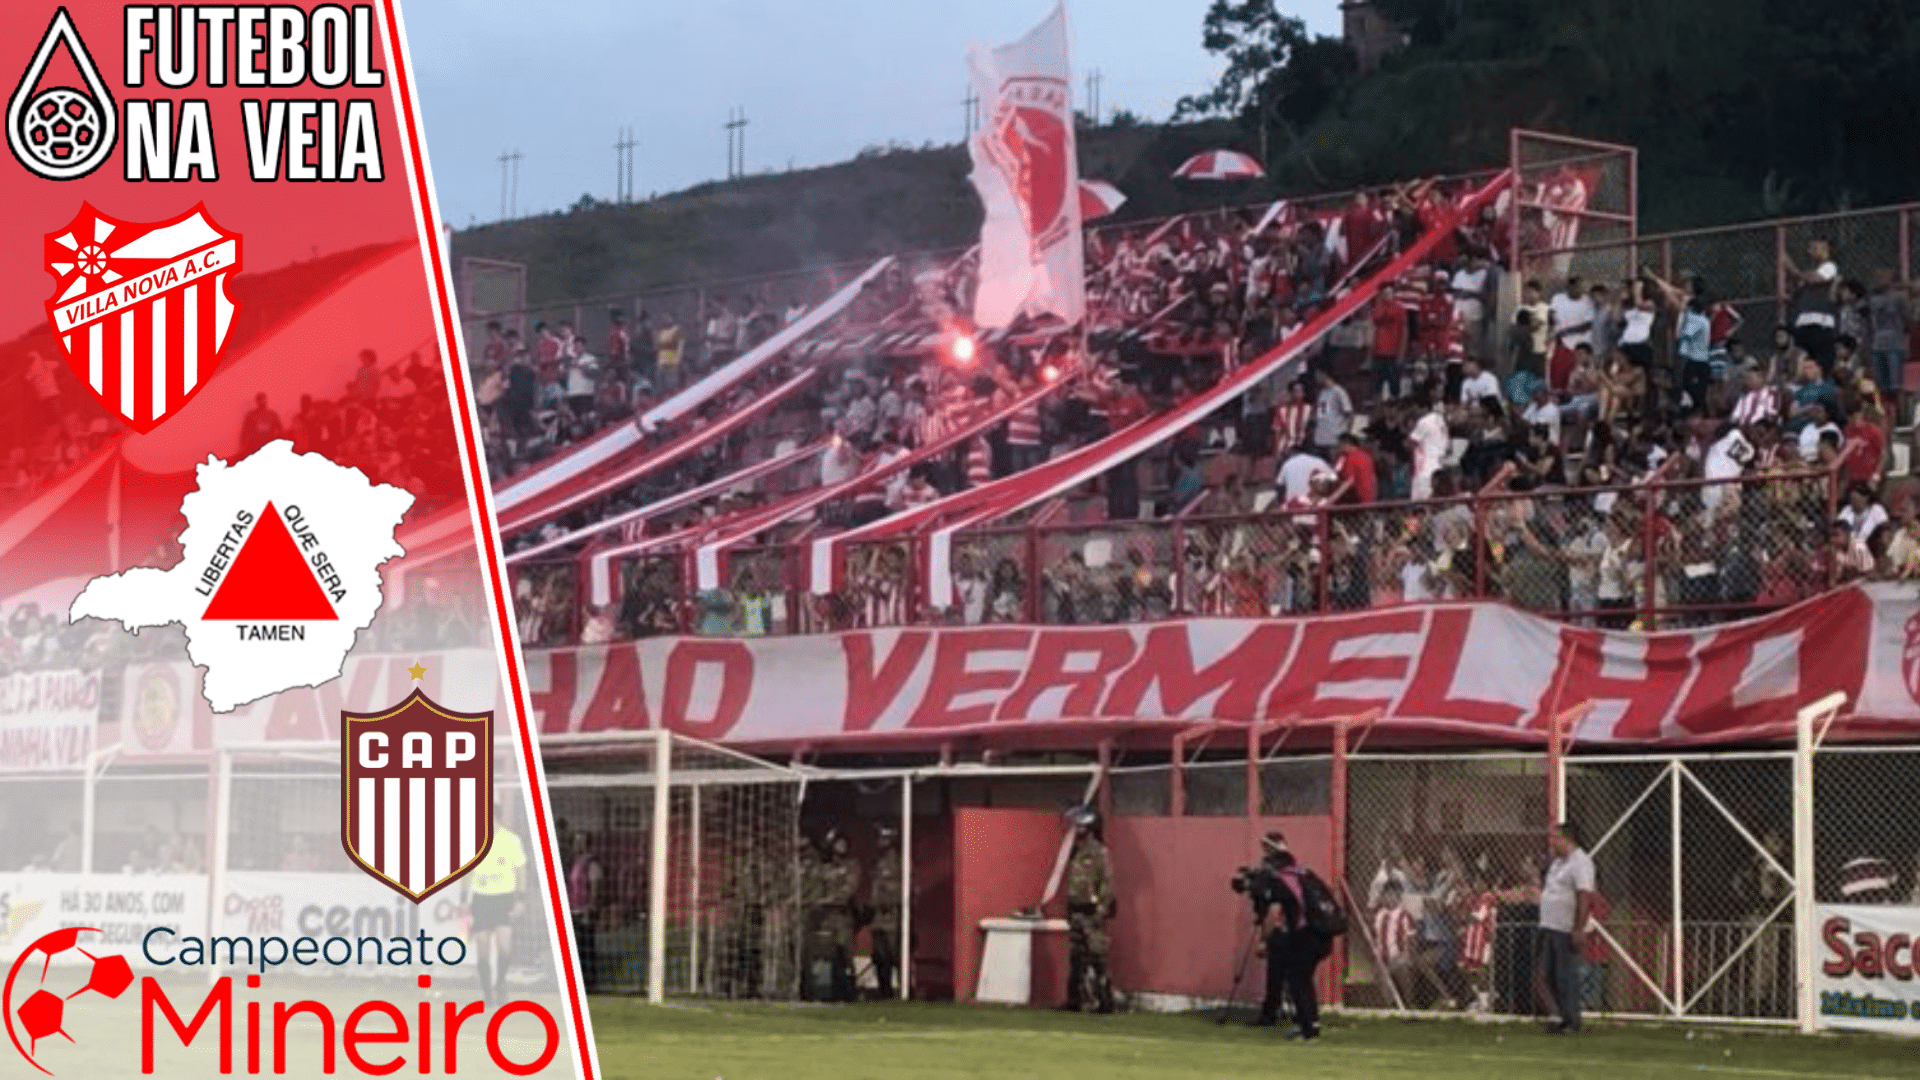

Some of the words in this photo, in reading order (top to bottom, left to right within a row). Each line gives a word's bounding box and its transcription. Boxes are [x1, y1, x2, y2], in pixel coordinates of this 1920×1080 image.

[841, 586, 1873, 740] VERMELHO
[297, 896, 420, 940] cemil
[1821, 914, 1920, 981] Sac
